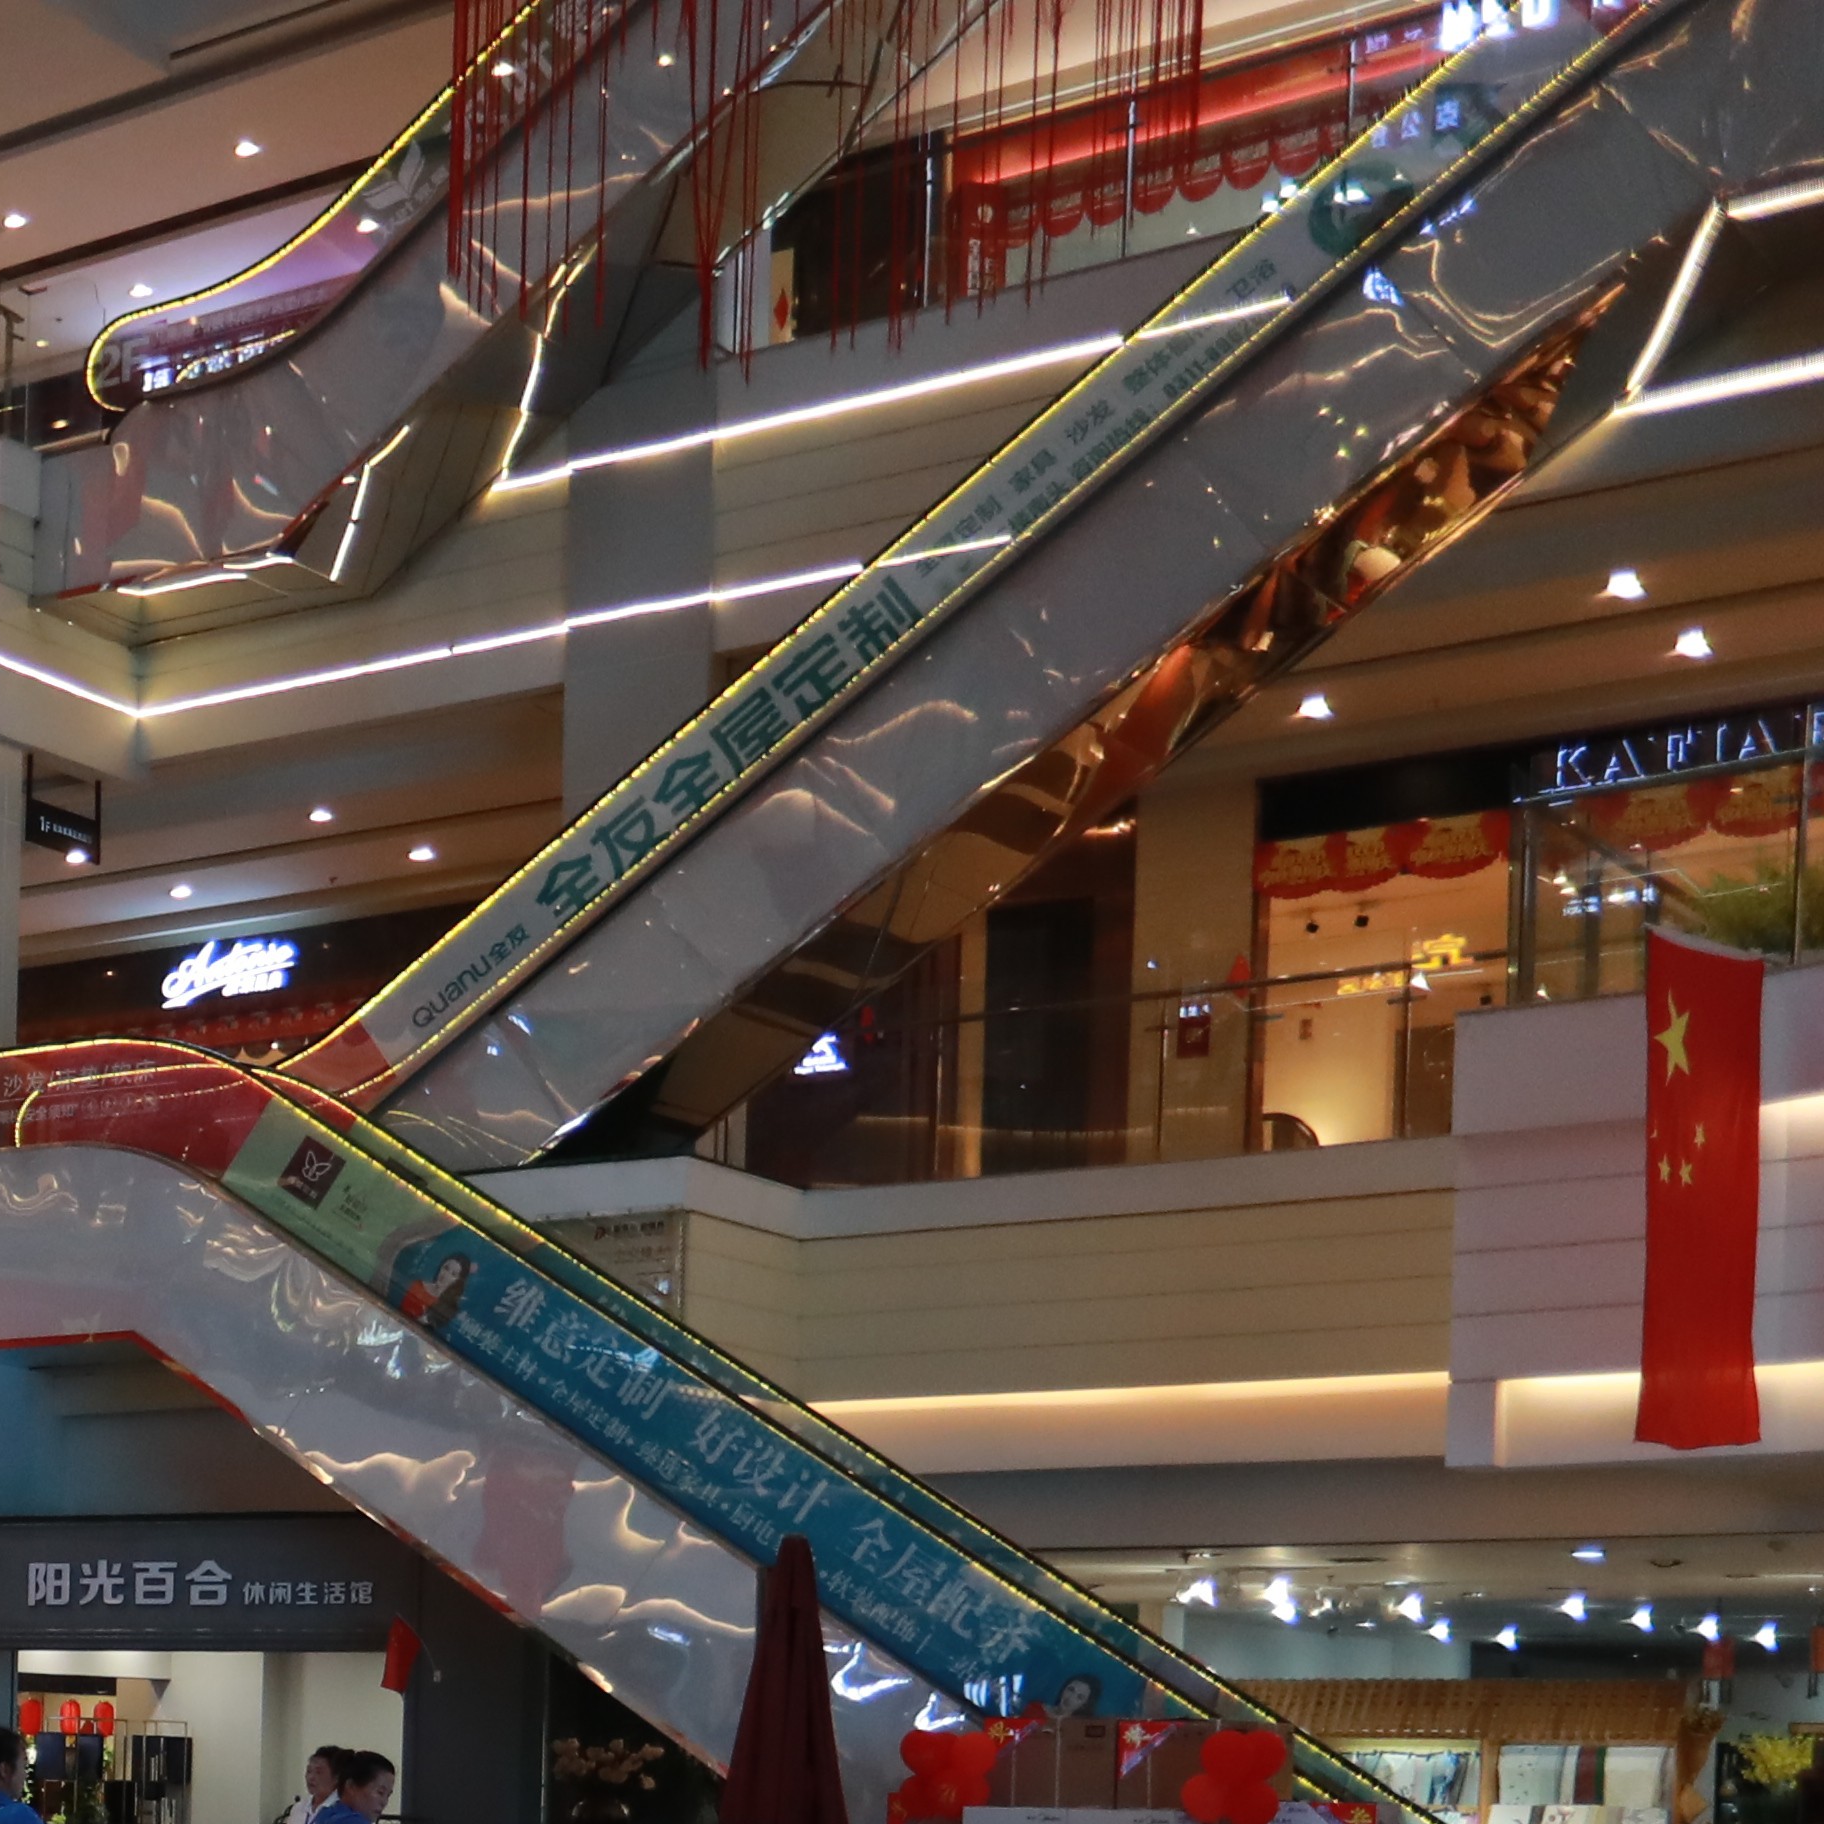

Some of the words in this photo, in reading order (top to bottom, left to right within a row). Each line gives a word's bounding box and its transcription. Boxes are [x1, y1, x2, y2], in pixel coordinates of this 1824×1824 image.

[534, 572, 923, 920] 全友全屋定制
[488, 922, 531, 967] 全友
[493, 1278, 670, 1421] 维意定制
[691, 1406, 831, 1525] 好设计
[852, 1517, 1042, 1664] 全屋配齐
[27, 1559, 233, 1607] 阳光百合
[242, 1581, 375, 1606] 休闲生活馆
